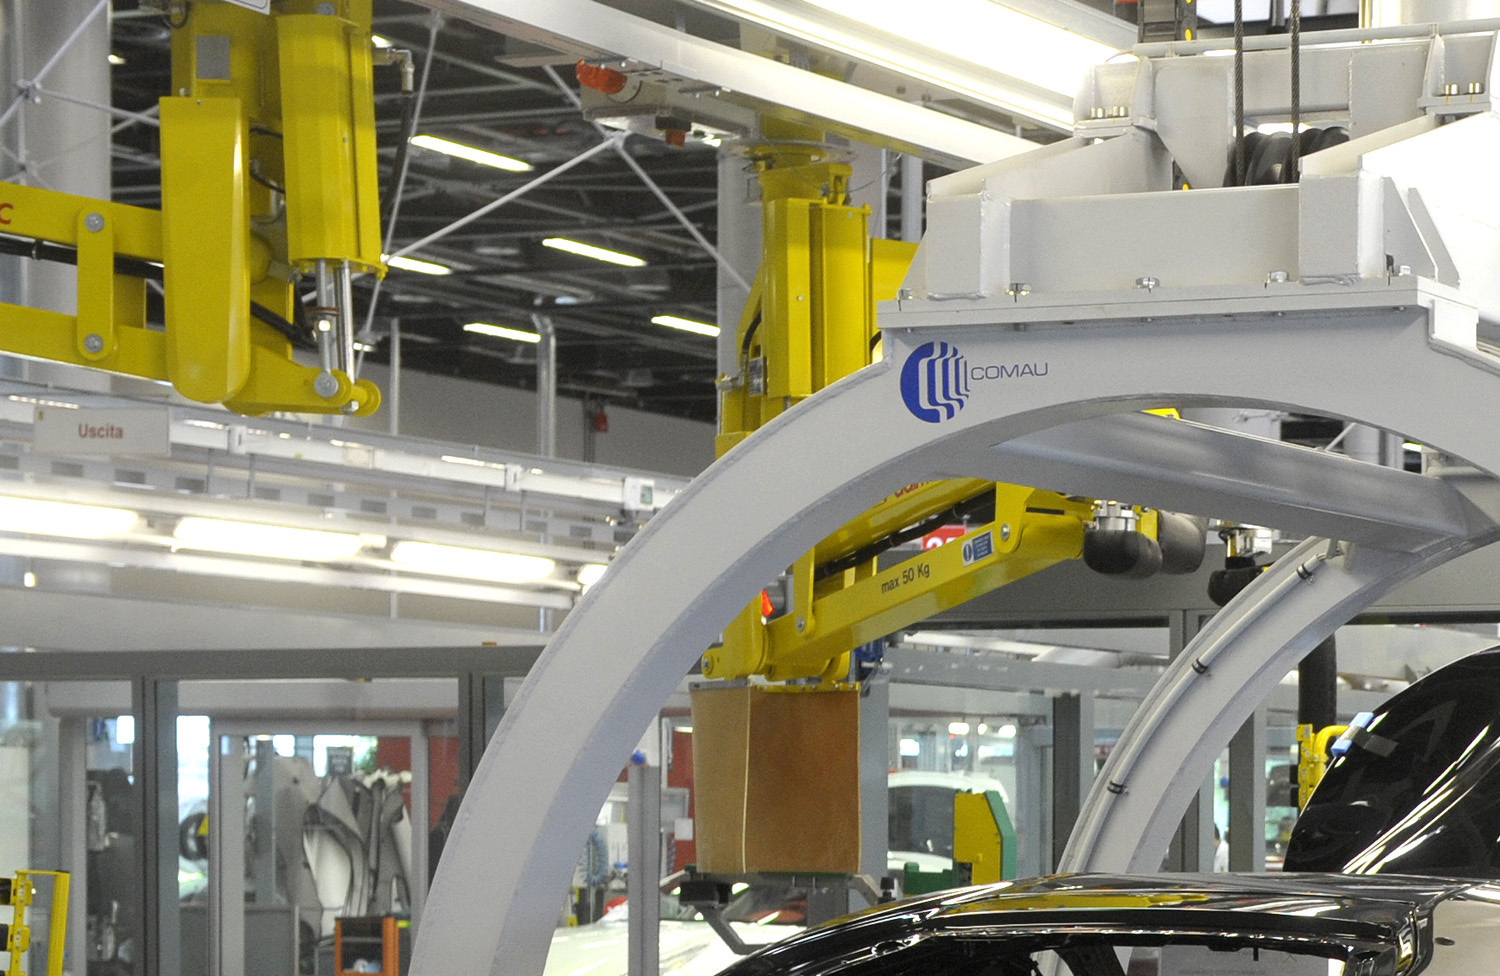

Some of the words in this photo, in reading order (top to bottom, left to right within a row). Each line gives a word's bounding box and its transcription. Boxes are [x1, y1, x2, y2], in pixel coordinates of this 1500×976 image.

[970, 362, 1049, 381] COMAU
[78, 423, 124, 439] Uscita
[881, 577, 900, 594] max
[902, 567, 915, 585] 50
[917, 563, 930, 579] Kg
